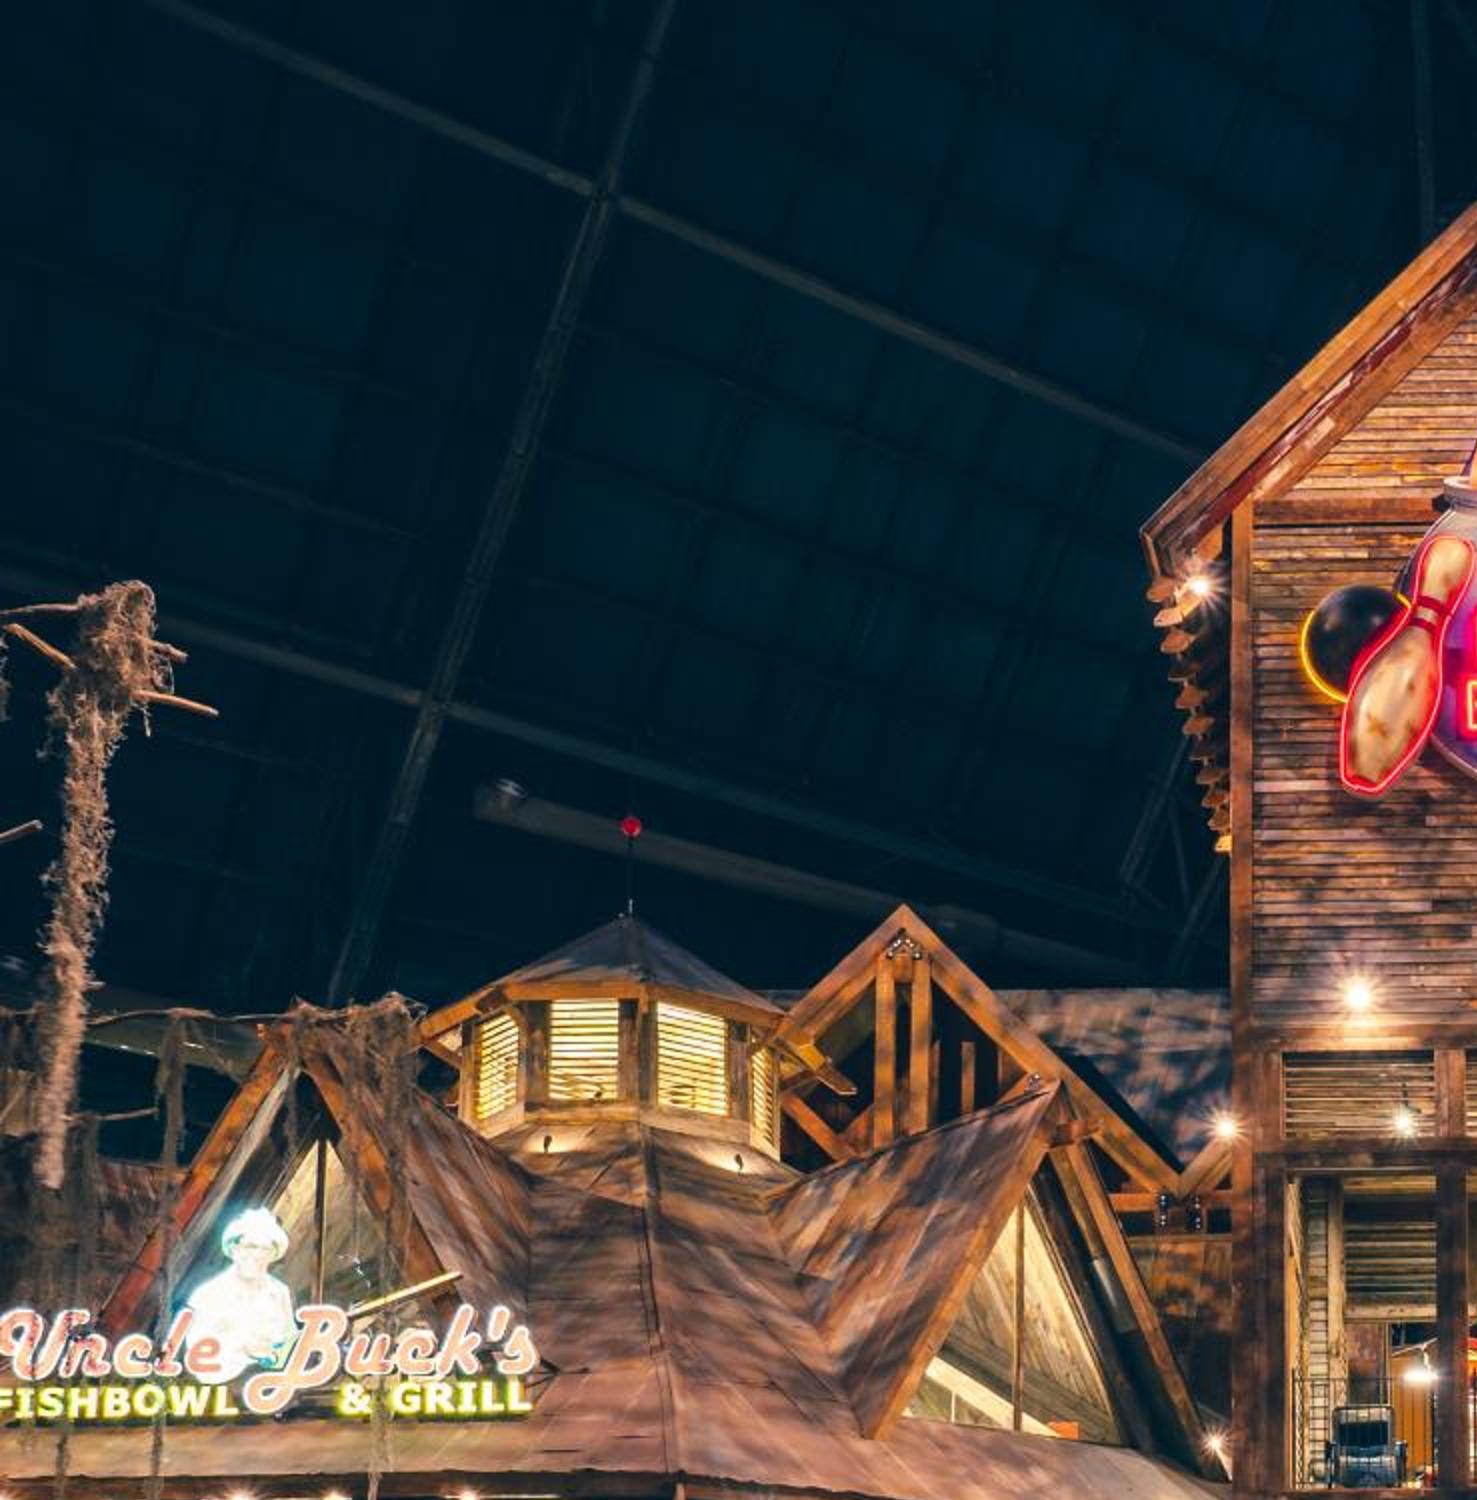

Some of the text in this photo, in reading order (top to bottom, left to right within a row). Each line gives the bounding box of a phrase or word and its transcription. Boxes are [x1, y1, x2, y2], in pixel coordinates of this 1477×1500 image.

[0, 1304, 537, 1413] Uncle Buck's
[338, 1382, 372, 1415] &
[390, 1381, 532, 1415] GRILL
